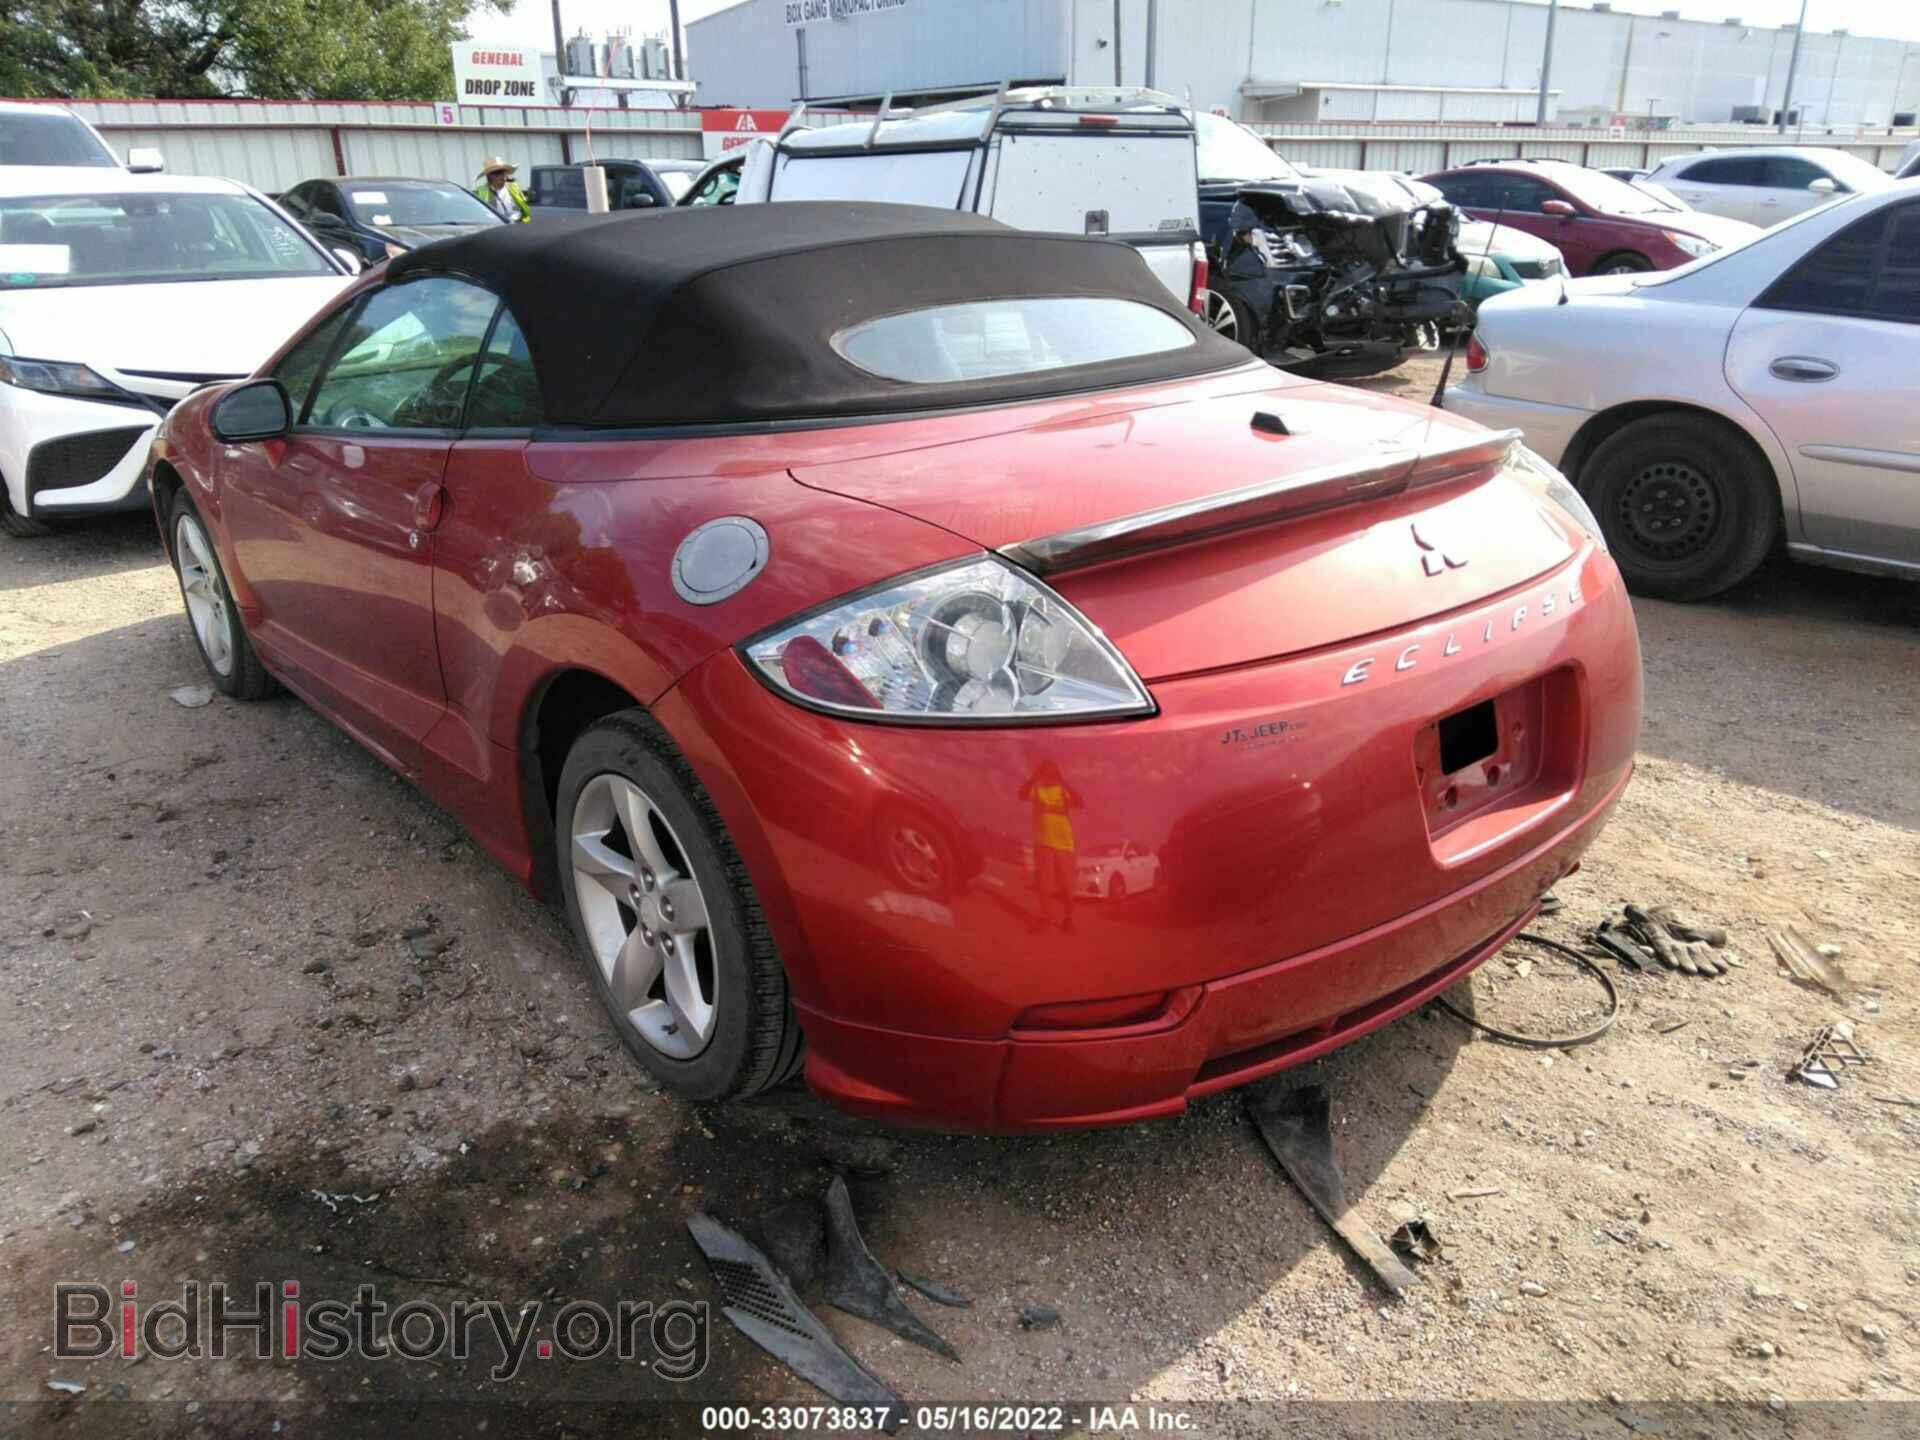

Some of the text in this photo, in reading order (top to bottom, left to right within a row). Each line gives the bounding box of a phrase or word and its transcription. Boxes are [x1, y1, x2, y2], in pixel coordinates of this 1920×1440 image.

[472, 51, 524, 66] GENERAL
[465, 79, 536, 97] DROP ZONE
[442, 106, 454, 124] 5
[1341, 585, 1586, 686] ECLIPSE
